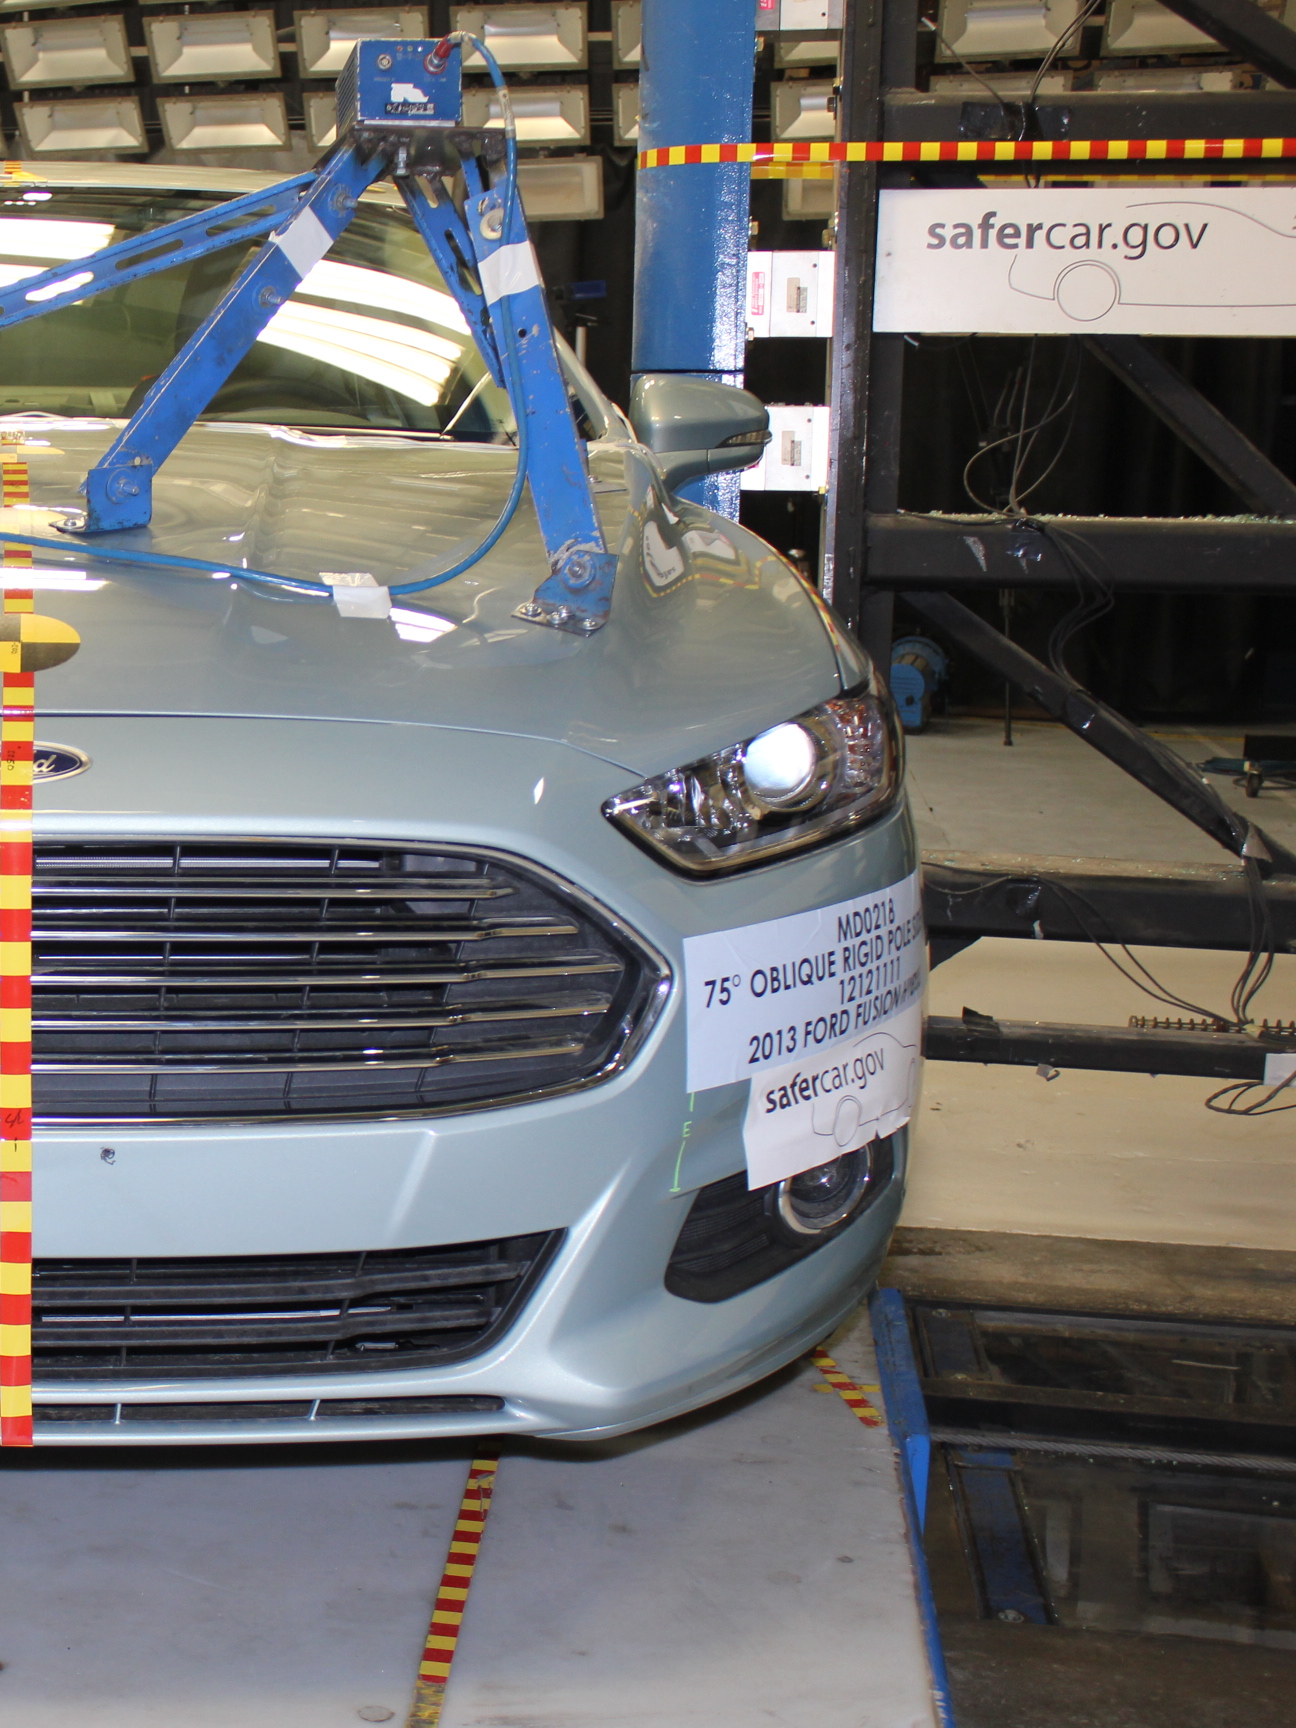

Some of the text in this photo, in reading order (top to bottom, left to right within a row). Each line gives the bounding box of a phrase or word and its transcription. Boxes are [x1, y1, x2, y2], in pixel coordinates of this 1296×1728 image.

[926, 211, 1209, 260] safercar.gov
[837, 898, 895, 943] MD0218
[750, 951, 836, 998] OBLIQUE
[843, 934, 883, 973] RIGID
[888, 919, 911, 955] POLE
[839, 956, 901, 1005] 12121111
[748, 1025, 797, 1064] 2013
[804, 1009, 850, 1048] FORD
[855, 984, 901, 1030] FUSION
[765, 1048, 885, 1113] safercar.gov
